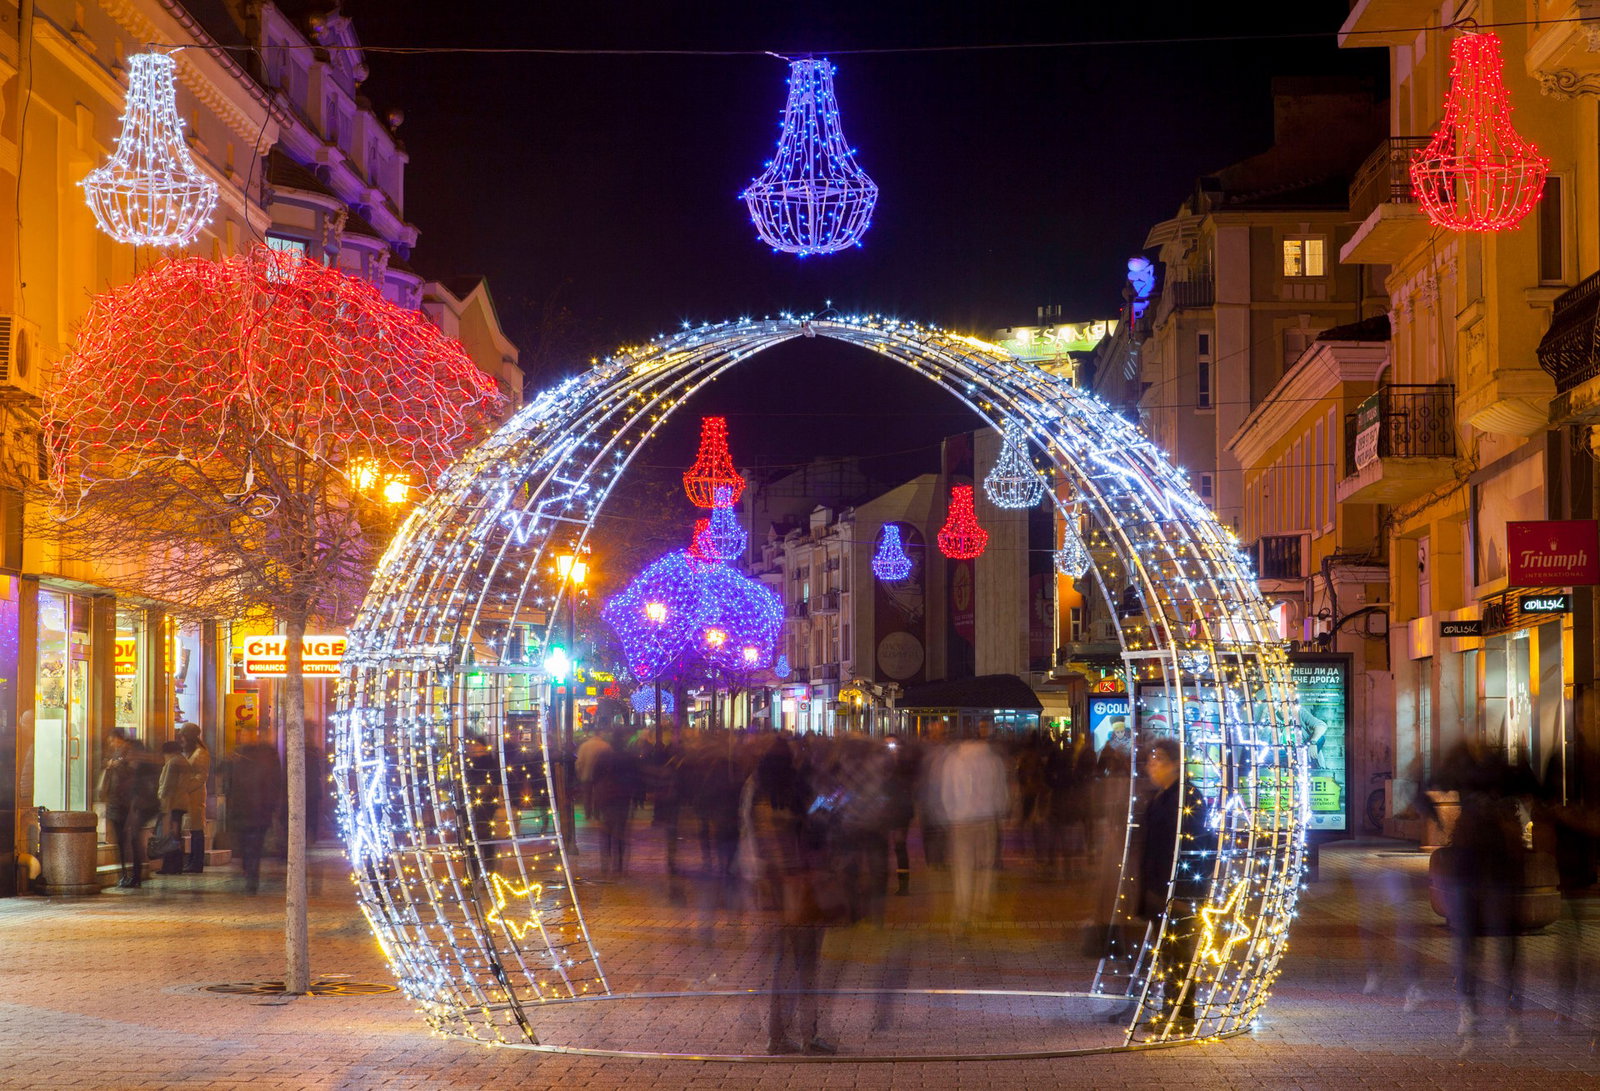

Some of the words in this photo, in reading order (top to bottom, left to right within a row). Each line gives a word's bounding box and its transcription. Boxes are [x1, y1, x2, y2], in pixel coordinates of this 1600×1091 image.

[1520, 549, 1588, 570] Triumph
[249, 664, 287, 672] ФИНАНСО
[1313, 667, 1326, 675] ЛИ
[1327, 667, 1339, 676] ДА
[1309, 676, 1340, 684] ДРОГА?
